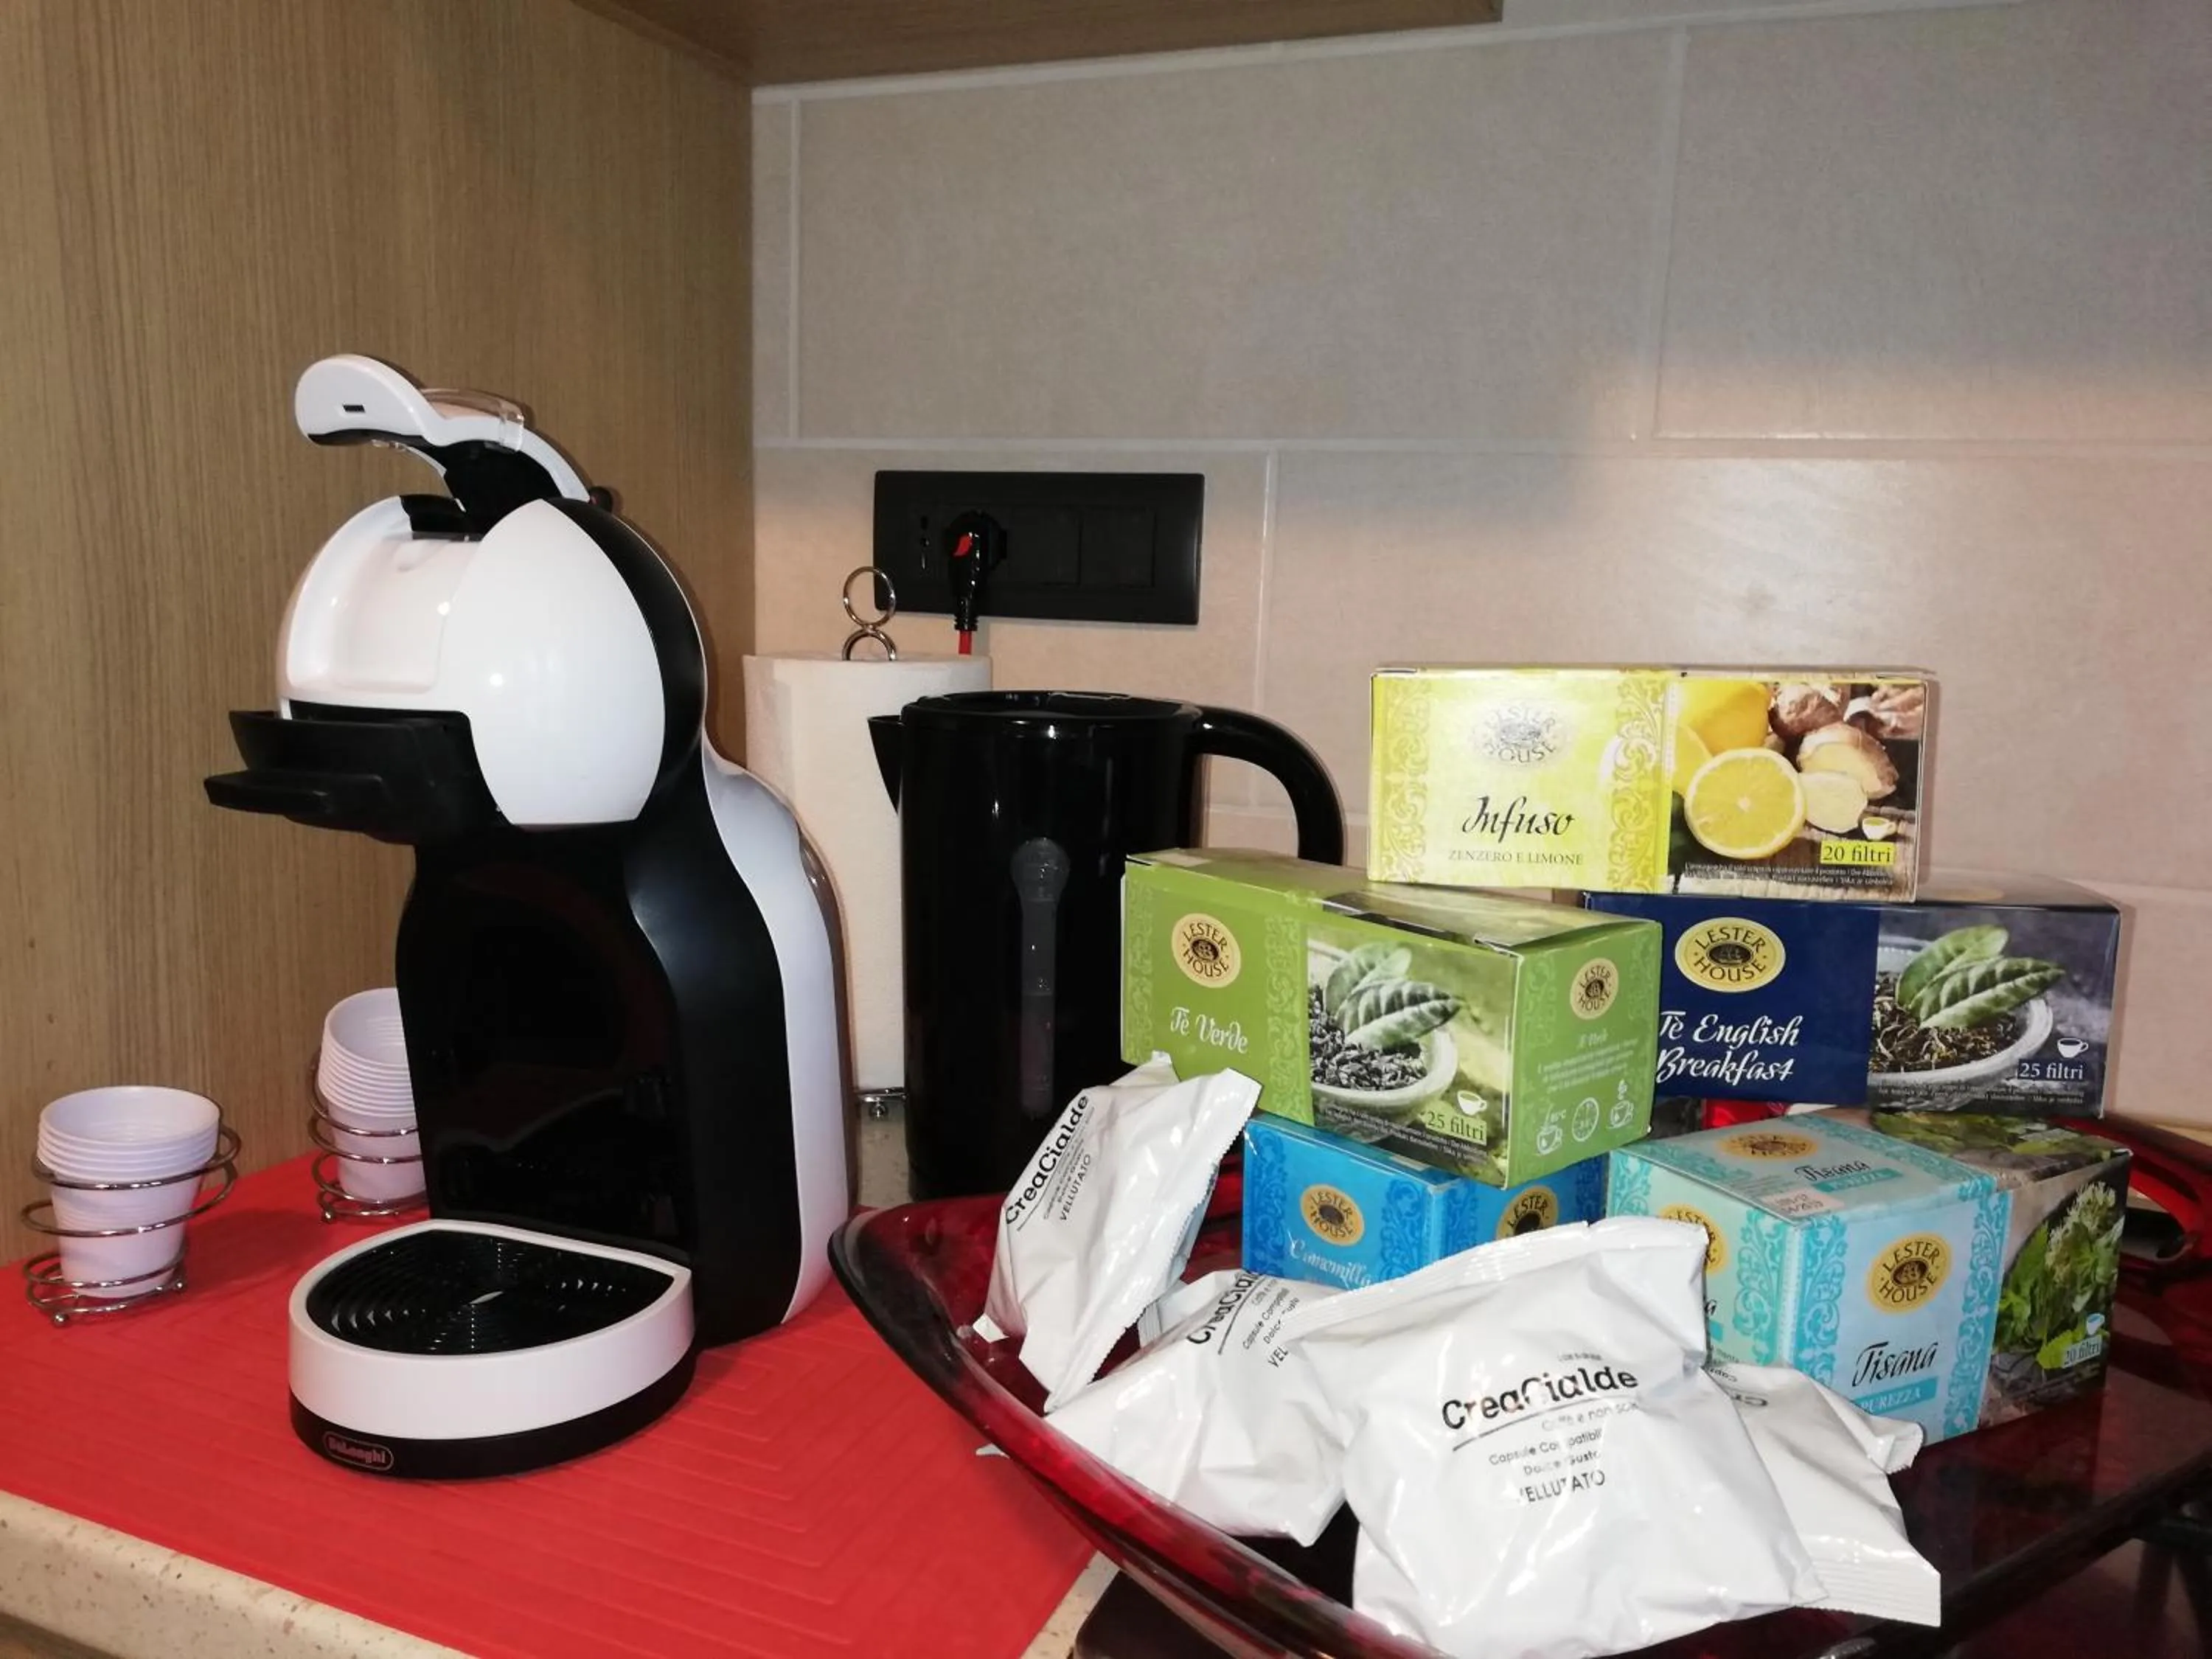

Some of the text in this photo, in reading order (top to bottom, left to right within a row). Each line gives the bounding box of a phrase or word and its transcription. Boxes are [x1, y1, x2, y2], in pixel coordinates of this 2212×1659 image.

[1462, 796, 1575, 844] Infuso
[1448, 849, 1585, 866] ZENZERO E LIMONE
[1823, 845, 1891, 862] 20 filtri
[1183, 922, 1228, 952] LESTER
[1695, 926, 1767, 953] LESTER
[1183, 947, 1229, 978] HOUSE
[1579, 965, 1611, 990] LESTER
[1694, 956, 1767, 982] HOUSE
[1578, 986, 1612, 1011] HOUSE
[1195, 1014, 1248, 1054] Verde
[1693, 1014, 1804, 1049] English
[1656, 1046, 1795, 1086] Breakfast
[2019, 1062, 2084, 1080] 25 filtri
[1427, 1110, 1484, 1141] 25 filtri
[1005, 1095, 1089, 1225] CreaCialde
[1060, 1153, 1091, 1221] VELLUTATO
[1310, 1191, 1353, 1220] LESTER
[1310, 1210, 1354, 1239] HOUSE
[1882, 1240, 1941, 1273] LESTER
[1879, 1273, 1938, 1304] HOUSE
[1851, 1340, 1939, 1388] Tisana
